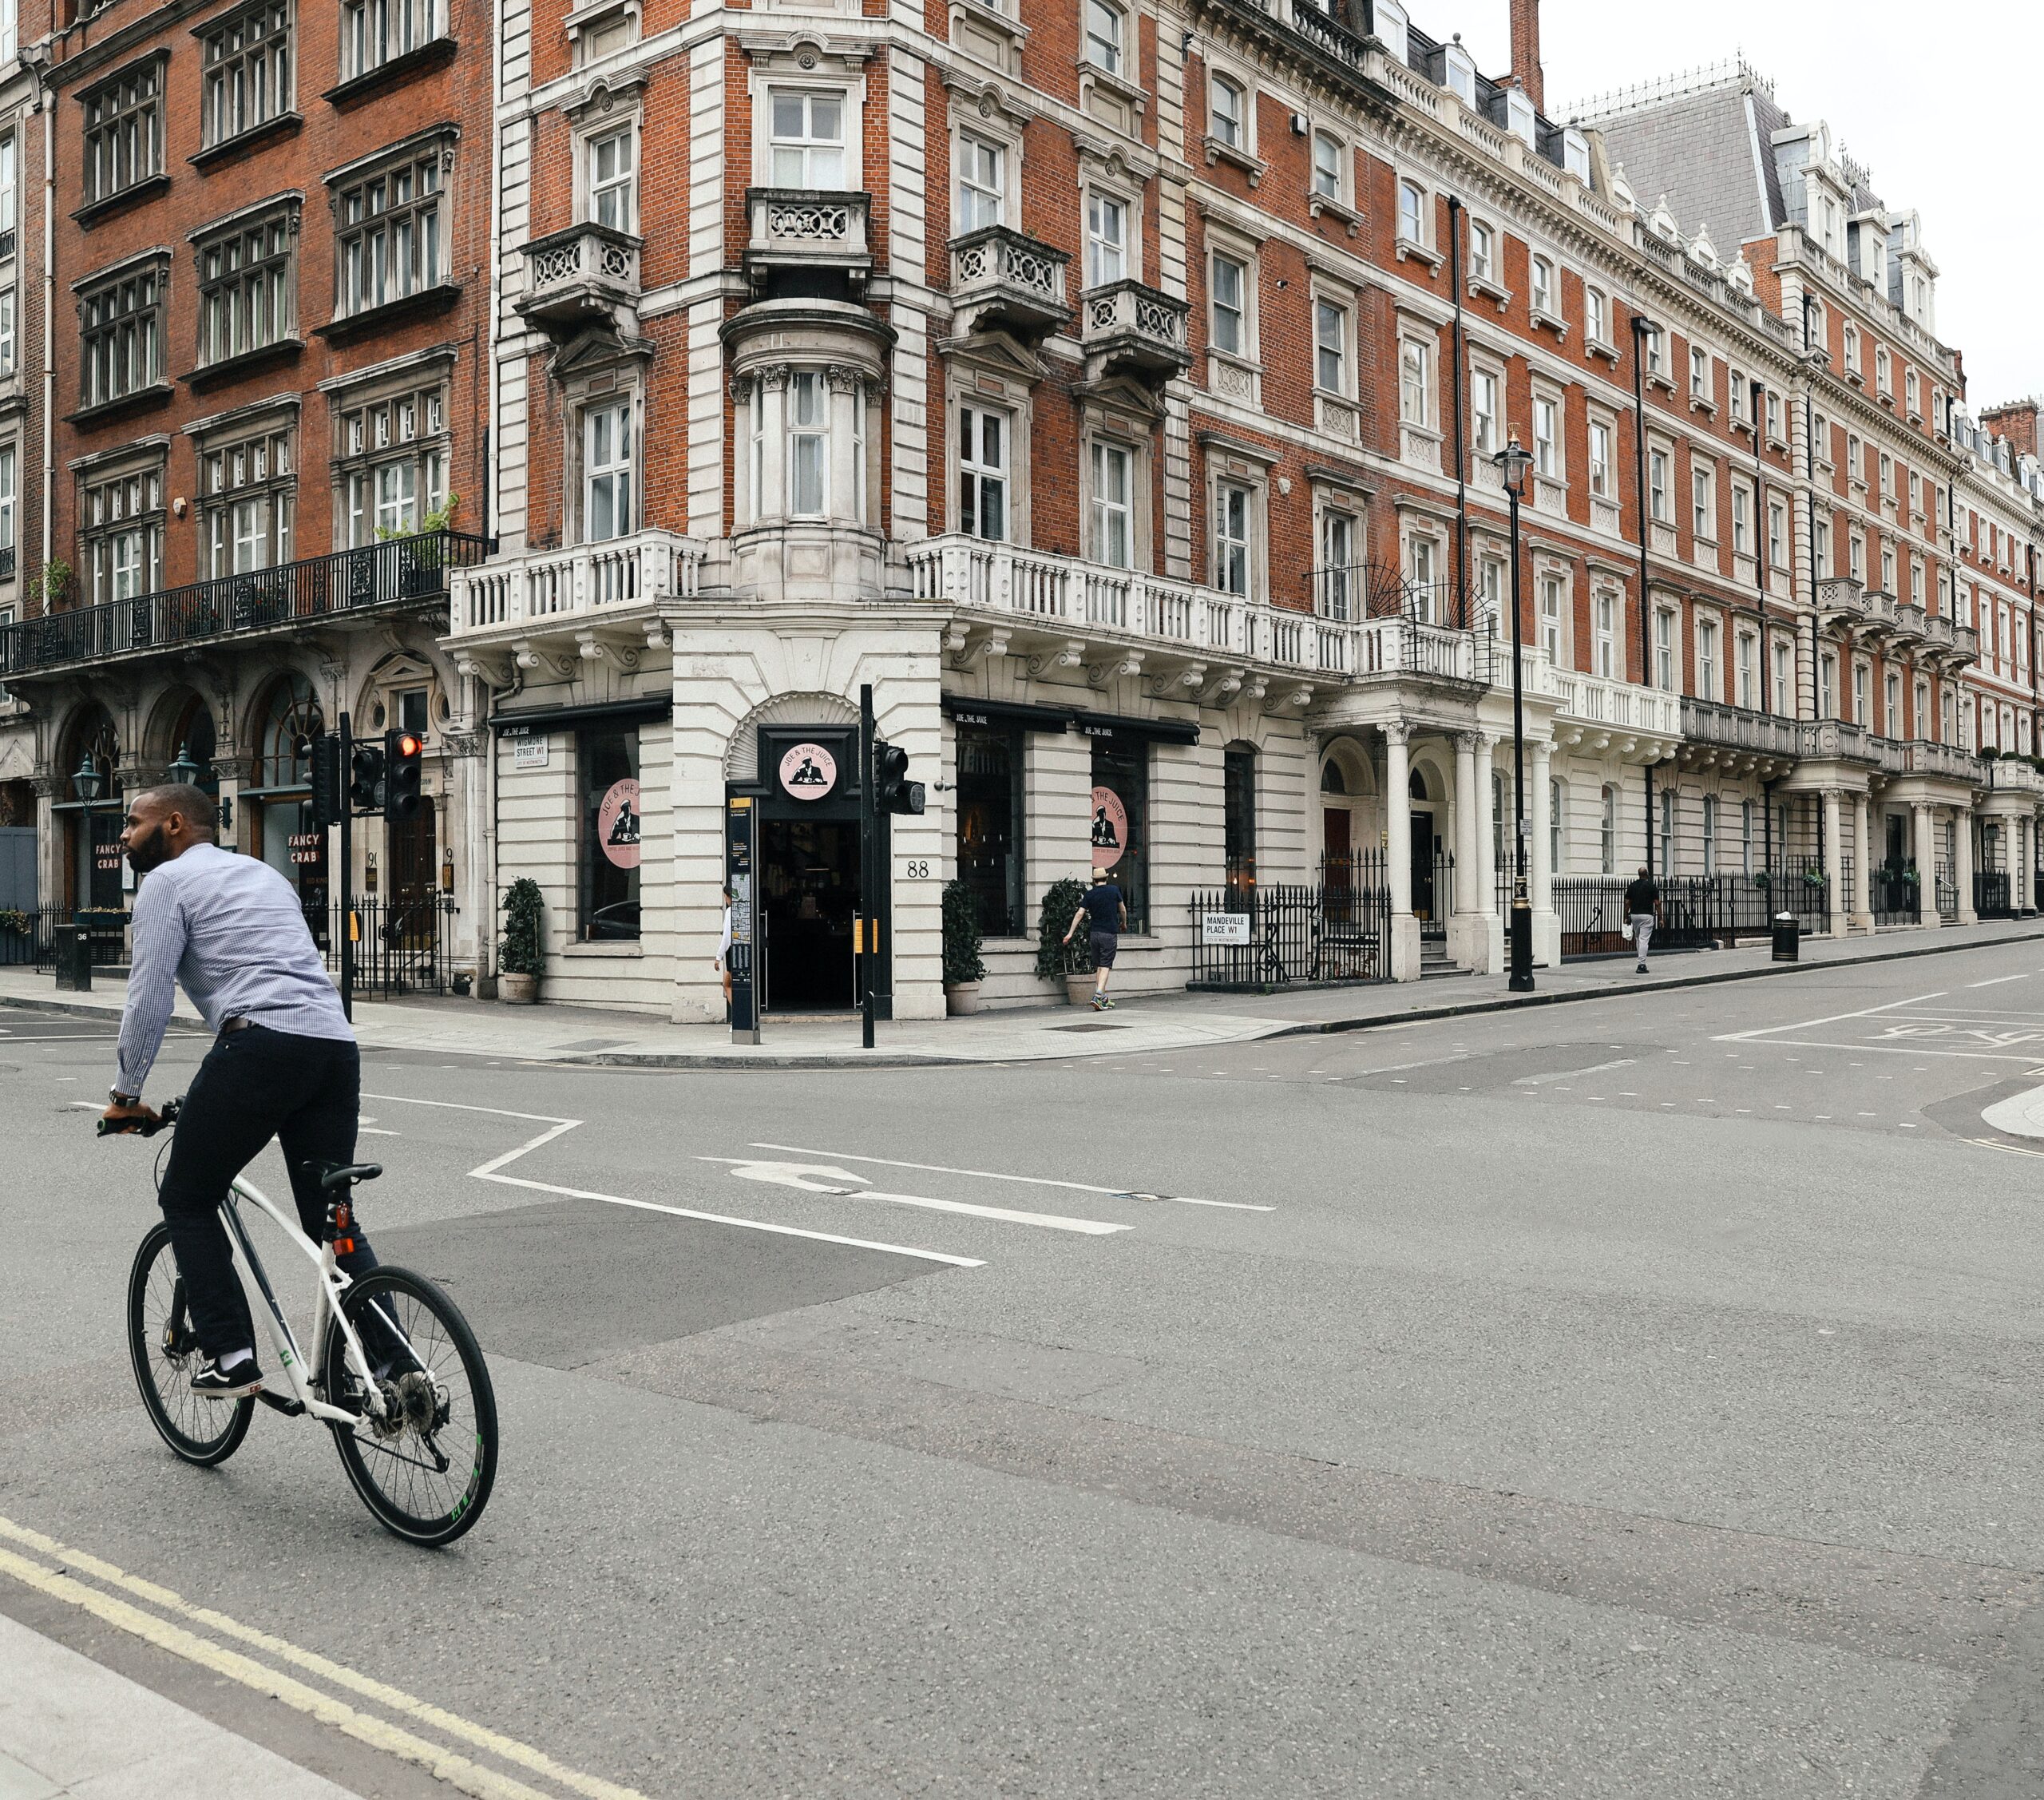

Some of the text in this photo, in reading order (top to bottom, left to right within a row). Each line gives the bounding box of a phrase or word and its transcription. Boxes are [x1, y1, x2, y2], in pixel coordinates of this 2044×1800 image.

[967, 715, 975, 723] THE
[517, 736, 543, 747] WIGMORE
[517, 747, 535, 757] STREET
[785, 754, 795, 766] JOE
[816, 751, 832, 767] JUICE
[602, 795, 613, 816] JOE
[613, 789, 619, 798] &
[621, 784, 634, 794] THE
[1095, 791, 1108, 802] THE
[1109, 797, 1124, 821] JUICE
[288, 834, 319, 846] FANCY
[96, 844, 121, 854] FANCY
[291, 852, 317, 862] CRAB
[98, 859, 119, 869] CRAB
[907, 860, 929, 878] 88
[1207, 916, 1244, 925] MANDEVILLE
